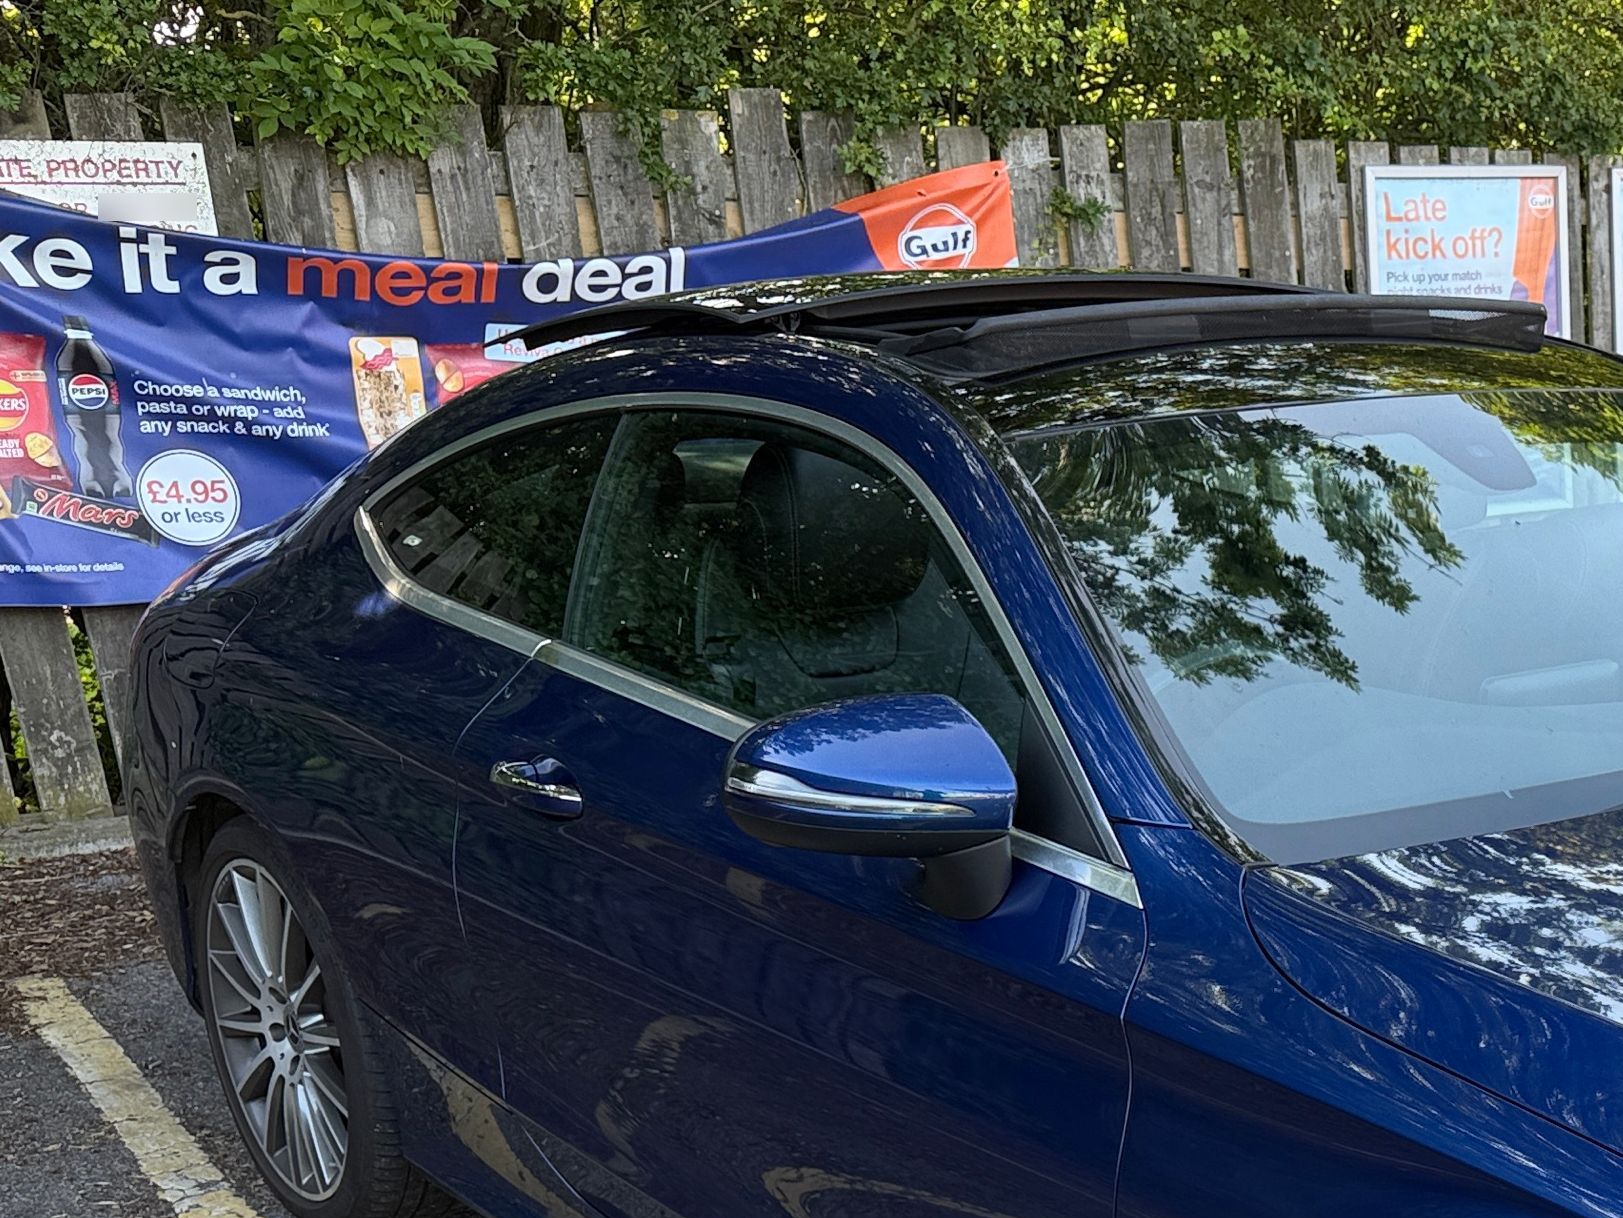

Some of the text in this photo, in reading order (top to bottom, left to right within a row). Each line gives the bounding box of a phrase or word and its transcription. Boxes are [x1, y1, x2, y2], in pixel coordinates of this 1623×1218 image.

[46, 158, 184, 179] PROPERTY
[1382, 191, 1447, 223] Late
[905, 230, 971, 257] Gulf
[1385, 227, 1503, 261] kick off?
[118, 227, 181, 294] it
[203, 250, 258, 296] a
[287, 257, 499, 306] meal
[521, 246, 686, 304] deal
[1386, 270, 1482, 285] Pick up your match
[1454, 284, 1472, 295] and
[1474, 283, 1503, 296] drinks
[72, 387, 106, 395] PEPSI
[133, 379, 306, 404] Choose a sandwich,
[137, 401, 188, 416] pasta
[192, 404, 211, 416] or
[214, 404, 259, 420] wrap
[273, 405, 306, 419] add
[140, 420, 173, 436] any
[176, 419, 231, 434] snack
[234, 421, 248, 435] &
[251, 423, 283, 439] any
[146, 479, 229, 505] £4.95
[38, 493, 140, 529] Mars
[161, 507, 225, 524] or less
[78, 562, 92, 572] for
